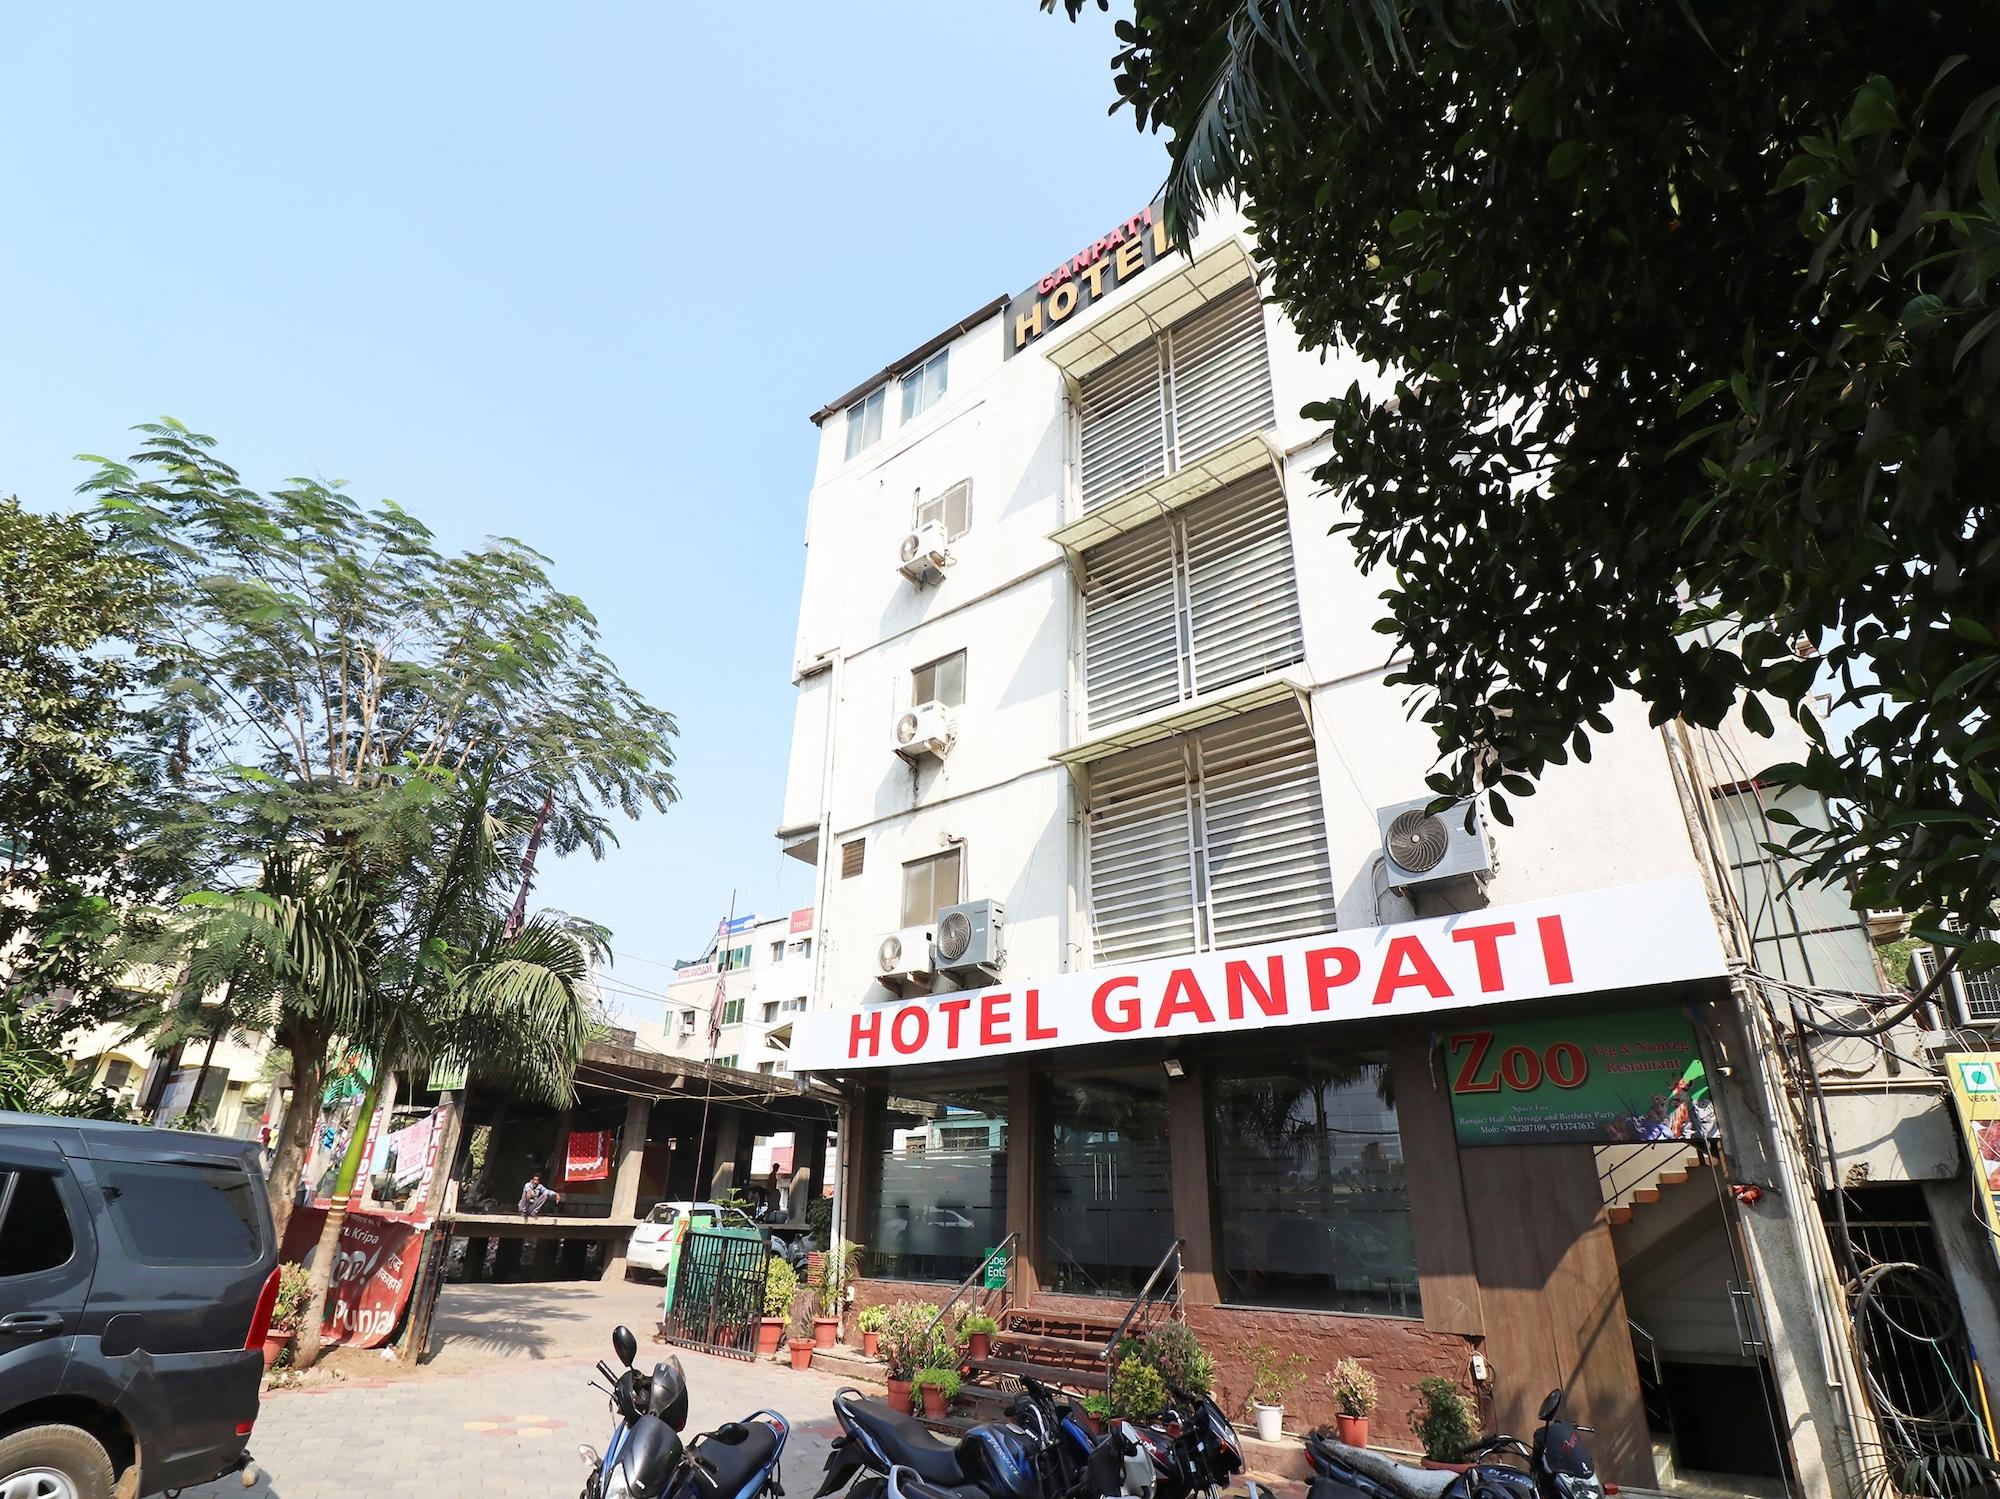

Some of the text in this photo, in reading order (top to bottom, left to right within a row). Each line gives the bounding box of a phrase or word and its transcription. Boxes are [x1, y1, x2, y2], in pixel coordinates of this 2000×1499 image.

[1038, 207, 1153, 296] GANPATI
[1015, 218, 1180, 348] HOTEL
[848, 914, 1574, 1059] HOTEL GANPATI
[1592, 1043, 1616, 1057] Veg
[1620, 1043, 1632, 1056] &
[1606, 1059, 1681, 1072] Restaurant
[1543, 1112, 1558, 1121] and
[353, 1111, 383, 1192] EXIDE
[417, 1109, 446, 1202] EXIDE
[351, 1227, 380, 1244] Kripa
[988, 1266, 1006, 1277] Eats
